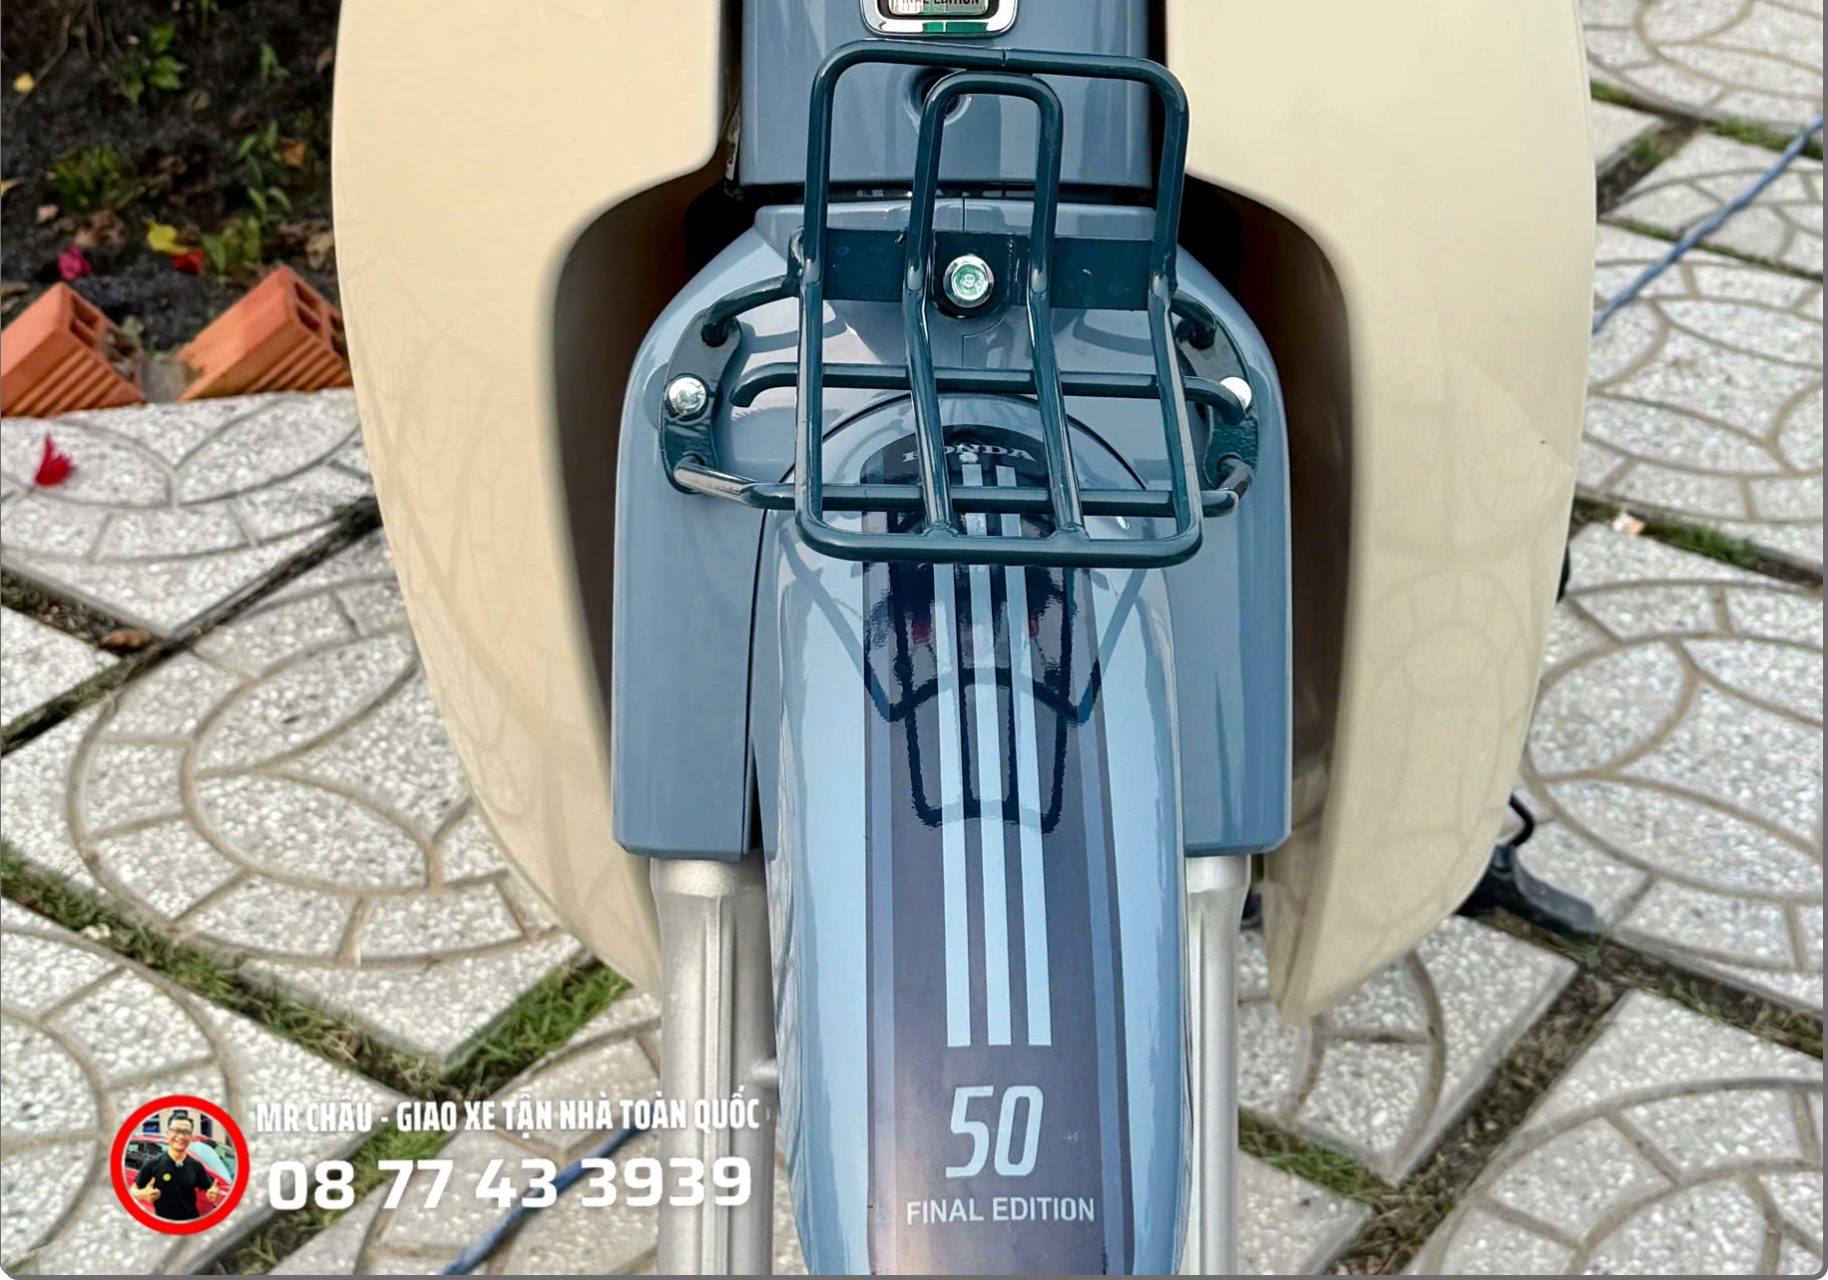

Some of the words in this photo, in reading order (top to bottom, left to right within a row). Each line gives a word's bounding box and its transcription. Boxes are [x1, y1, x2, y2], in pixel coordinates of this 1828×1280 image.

[945, 1084, 1044, 1178] 50
[907, 1197, 984, 1225] FINAL
[992, 1197, 1095, 1222] EDITION
